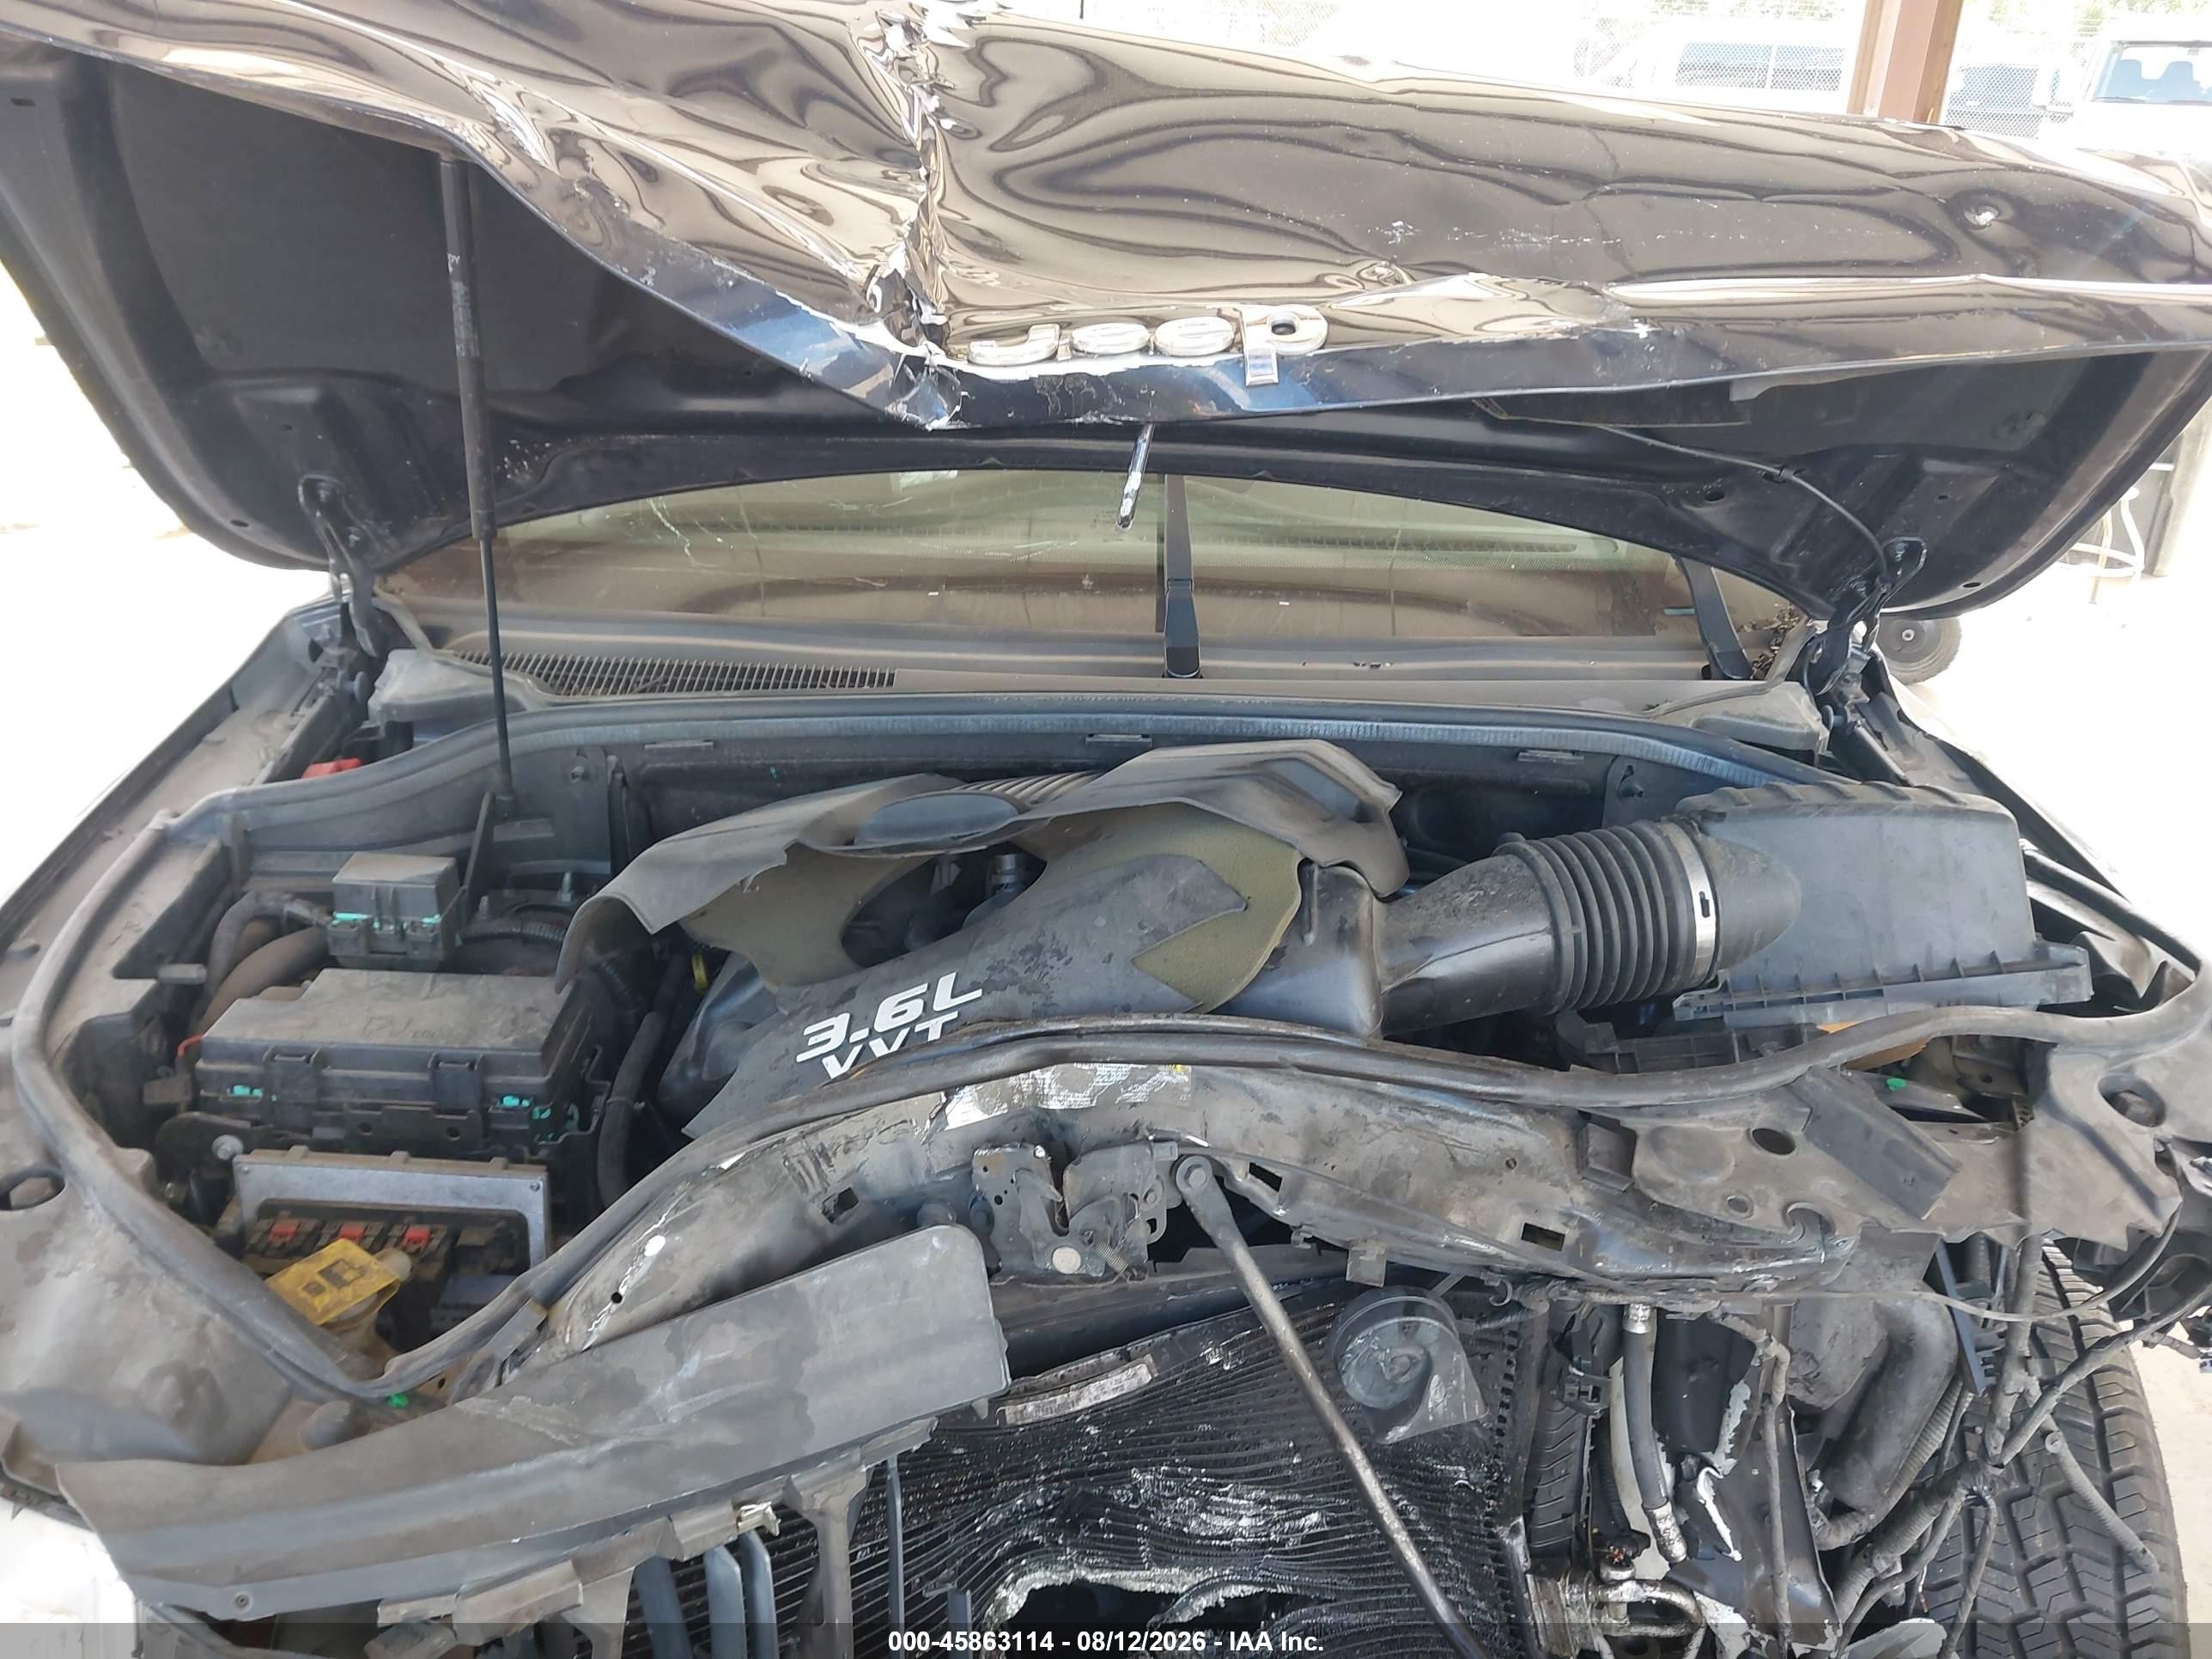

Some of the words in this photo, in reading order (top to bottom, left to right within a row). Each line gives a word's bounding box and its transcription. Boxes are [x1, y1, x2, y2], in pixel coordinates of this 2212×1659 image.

[967, 303, 1328, 387] Jeep
[795, 970, 983, 1063] 3.6L
[821, 1010, 959, 1079] VVT
